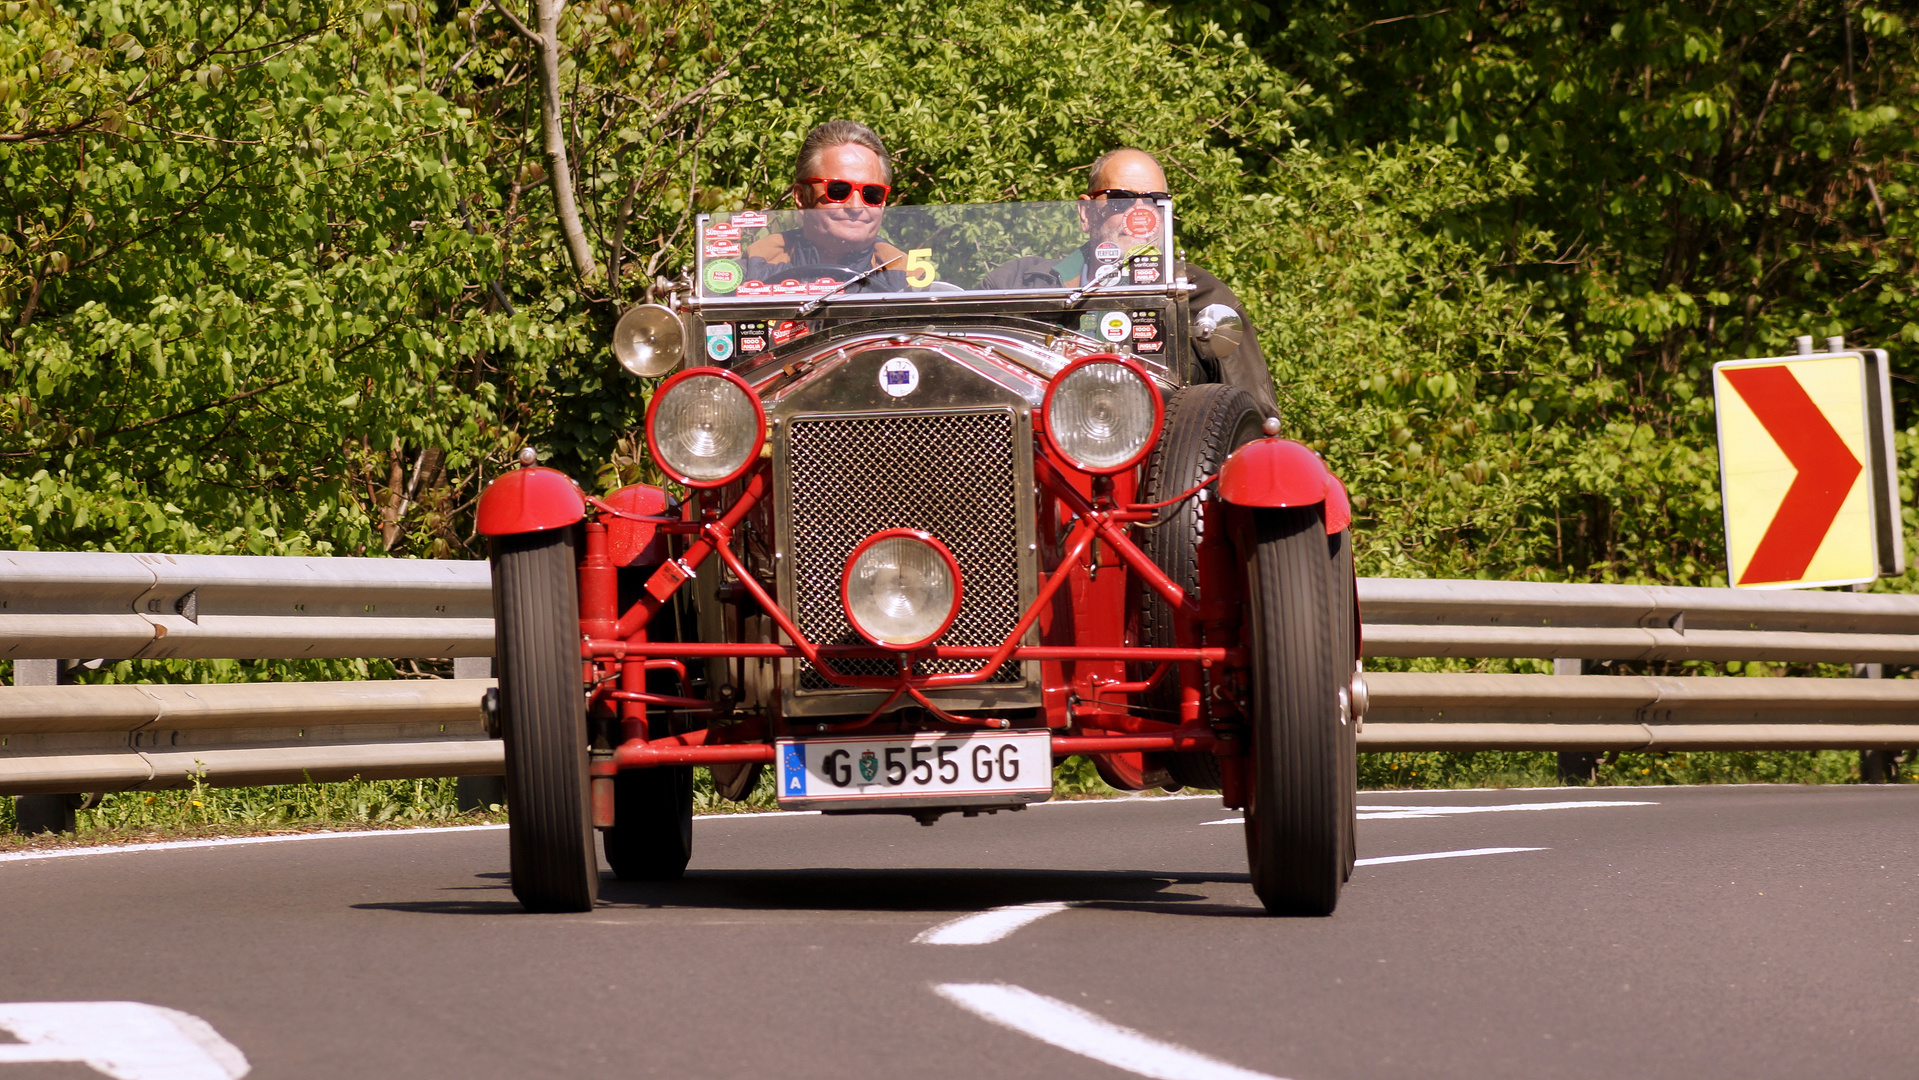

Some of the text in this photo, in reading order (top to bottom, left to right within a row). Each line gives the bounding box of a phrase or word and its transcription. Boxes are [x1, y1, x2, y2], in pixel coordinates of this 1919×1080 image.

[906, 248, 936, 288] 5
[790, 777, 801, 789] A
[830, 744, 1019, 788] G 555 GG
